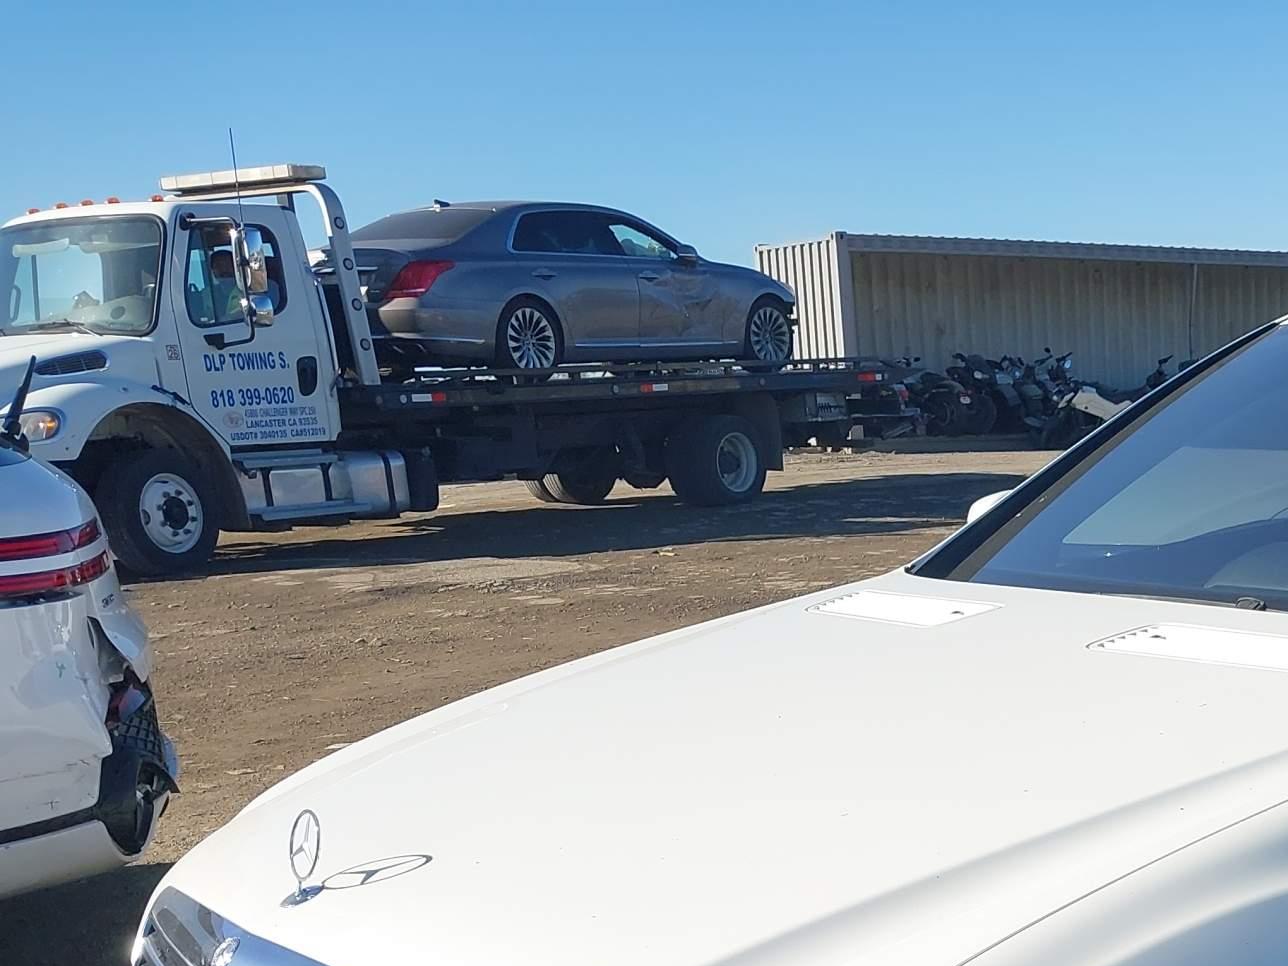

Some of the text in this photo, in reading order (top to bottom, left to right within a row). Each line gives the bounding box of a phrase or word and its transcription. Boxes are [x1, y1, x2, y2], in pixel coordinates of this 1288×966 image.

[203, 351, 290, 372] DLP TOWING S.
[211, 386, 295, 408] 818 399-0620
[245, 419, 287, 429] LANCASTER
[288, 418, 298, 427] CA
[231, 431, 258, 441] USDOT#
